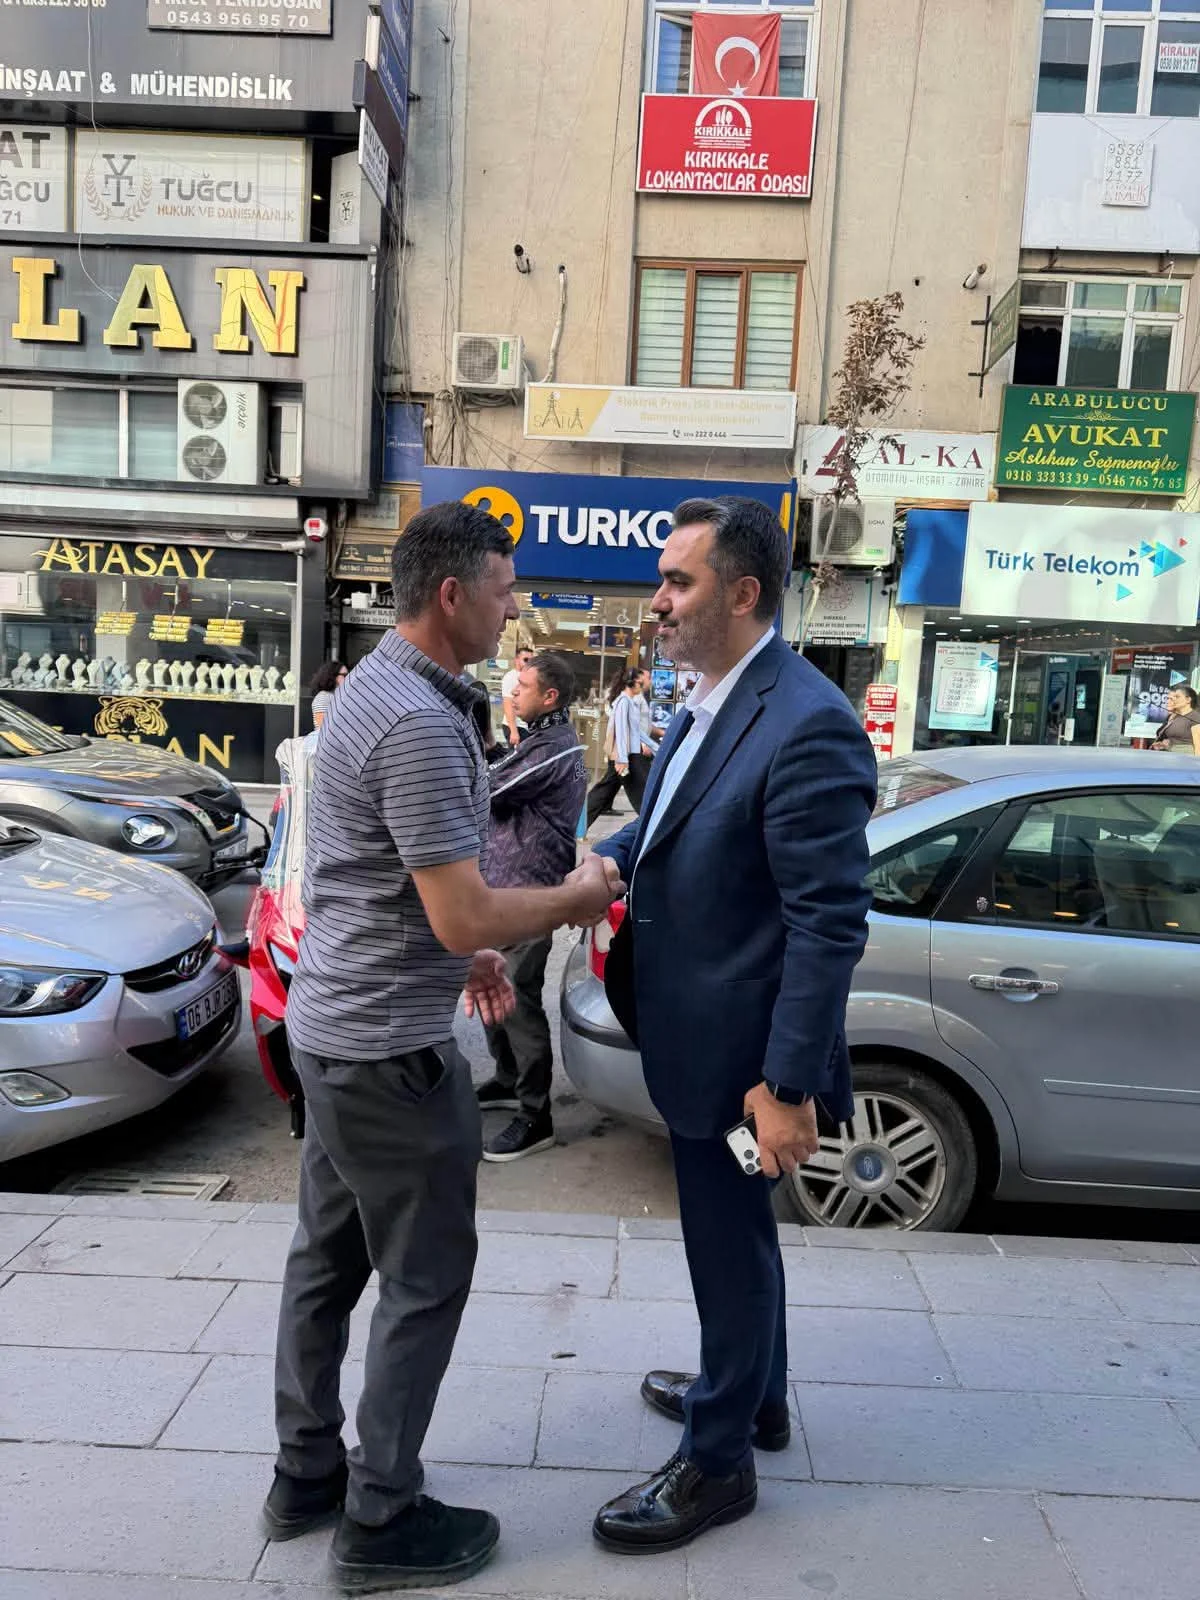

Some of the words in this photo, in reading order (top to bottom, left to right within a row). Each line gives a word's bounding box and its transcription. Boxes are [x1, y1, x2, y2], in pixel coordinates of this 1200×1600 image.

[167, 10, 213, 25] 0543
[218, 12, 253, 26] 956
[258, 13, 281, 27] 95
[287, 14, 309, 28] 70
[0, 63, 86, 97] İNŞAAT
[99, 71, 117, 94] &
[130, 70, 293, 101] MÜHENDİSLİK
[684, 150, 769, 170] KIRIKKALE
[159, 171, 254, 204] TUĞCU
[645, 169, 757, 192] LOKANTACILAR
[761, 174, 808, 193] ODASI
[3, 210, 21, 225] 71
[157, 204, 195, 217] HUKUK
[199, 206, 215, 218] VE
[11, 256, 304, 353] LAN
[237, 391, 249, 433] arçelik
[1029, 391, 1169, 412] ARABULUCU
[1022, 422, 1168, 448] AVUKAT
[1004, 447, 1079, 467] Aslıhan
[1083, 449, 1180, 476] Seğmenoğlu
[1006, 469, 1032, 482] 0318
[1036, 470, 1059, 483] 333
[1059, 471, 1073, 483] 33
[1075, 471, 1089, 485] 39
[1098, 473, 1126, 487] 0546
[1129, 474, 1149, 488] 765
[1152, 476, 1165, 489] 76
[1168, 477, 1182, 489] 85
[530, 505, 674, 549] TURKC
[34, 538, 216, 579] ATASAY
[985, 549, 1035, 571] Türk
[1043, 552, 1140, 577] Telekom
